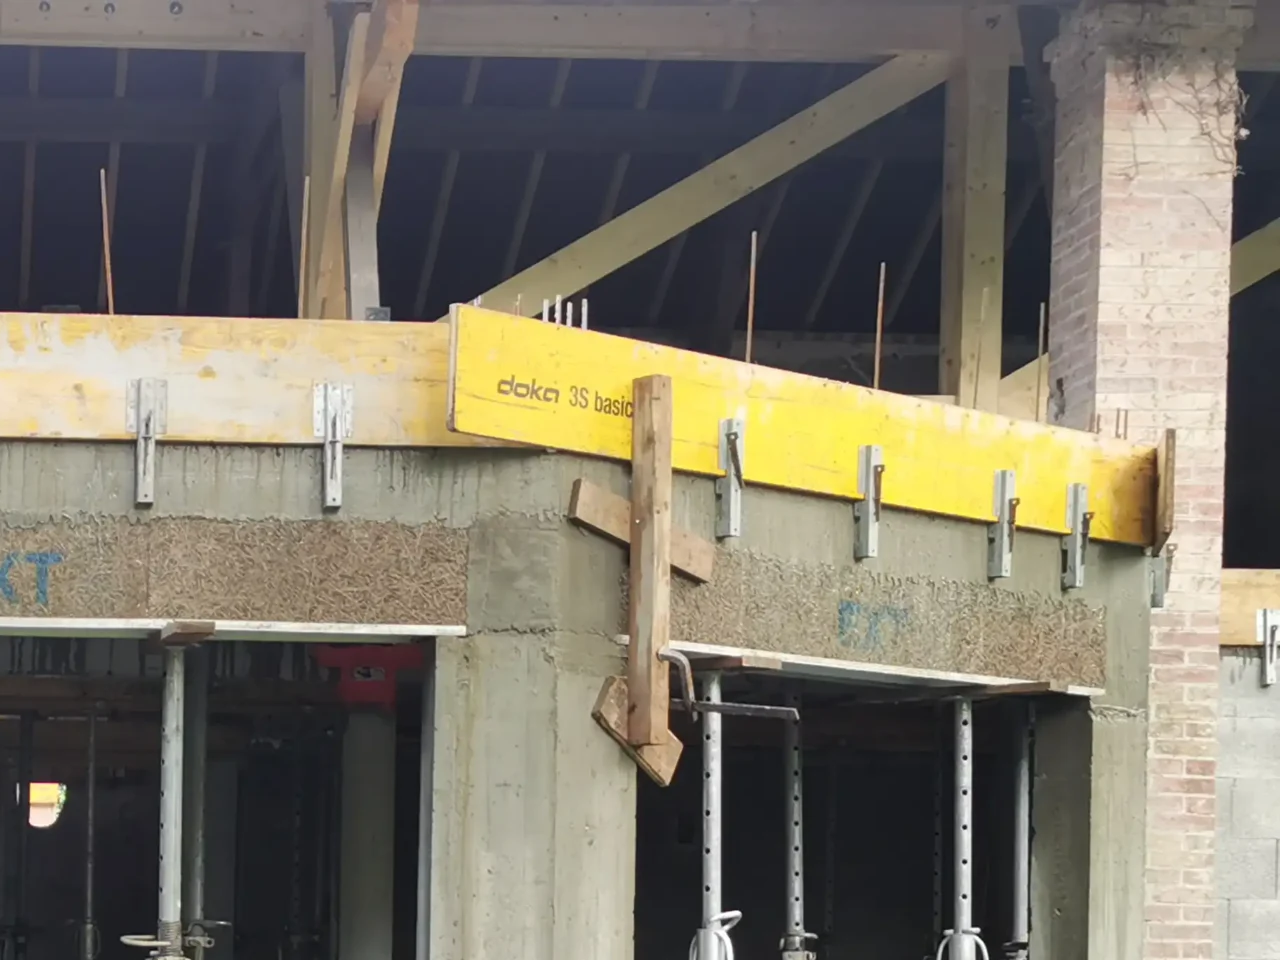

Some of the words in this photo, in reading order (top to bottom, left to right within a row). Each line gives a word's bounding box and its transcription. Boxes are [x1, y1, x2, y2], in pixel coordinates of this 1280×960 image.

[497, 374, 560, 403] doka
[569, 385, 589, 409] 3S
[594, 390, 634, 418] basic
